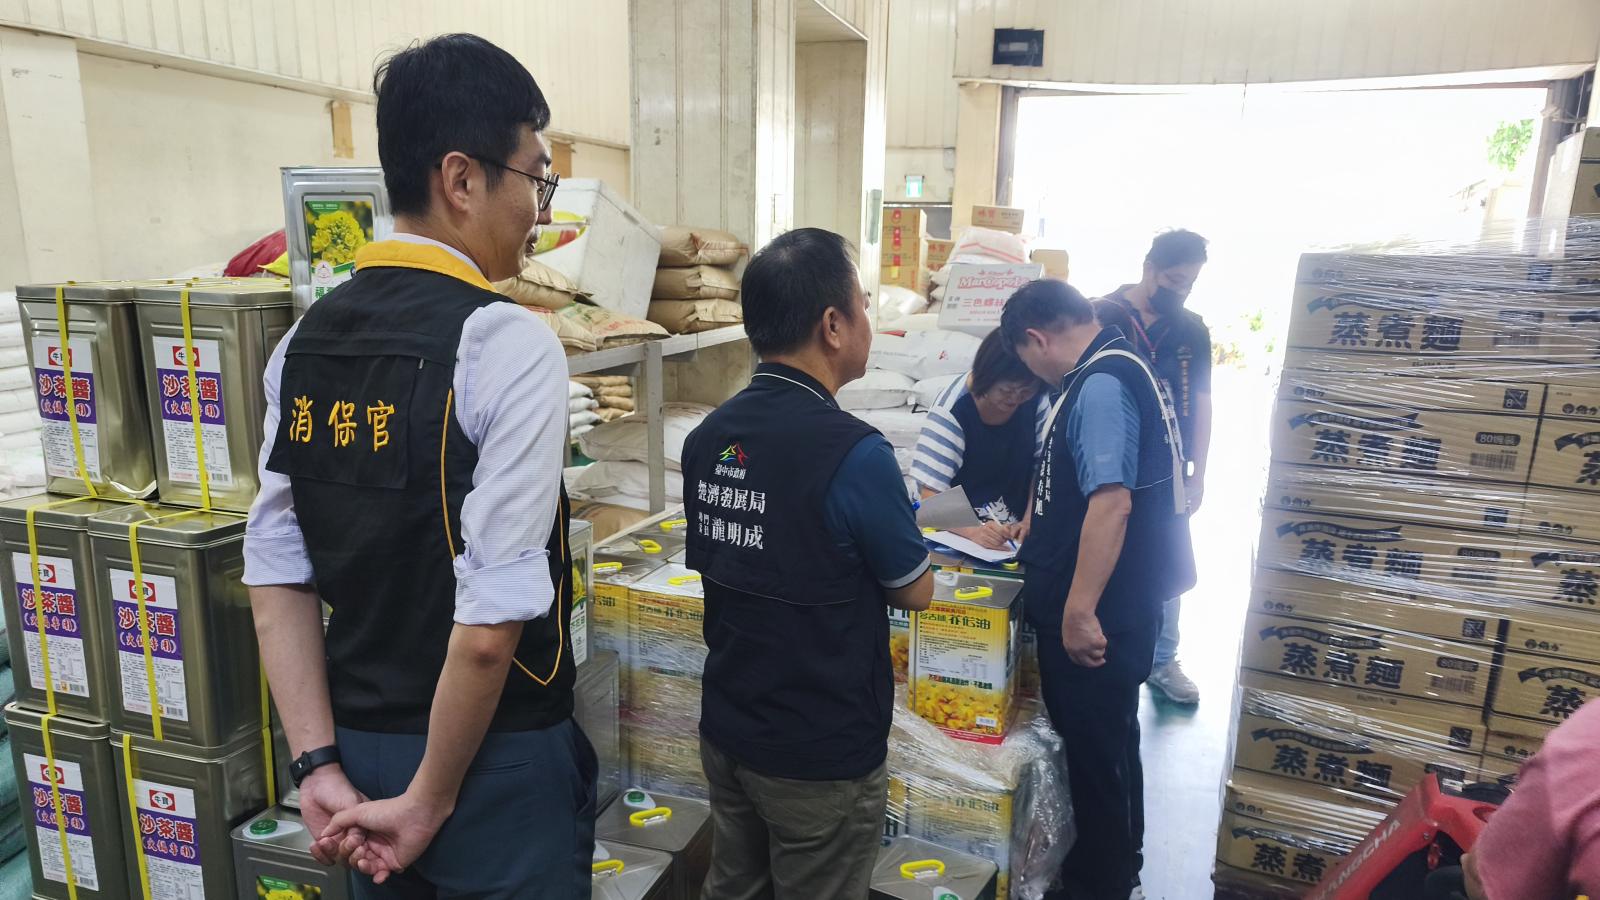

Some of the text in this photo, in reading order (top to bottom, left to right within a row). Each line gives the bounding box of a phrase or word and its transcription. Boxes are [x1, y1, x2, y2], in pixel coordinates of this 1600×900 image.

[290, 395, 395, 452] 消保官
[698, 480, 766, 514] 經濟發展局
[712, 516, 764, 550] 龍明成
[139, 813, 194, 844] 沙茶醬
[1251, 843, 1328, 882] 蒸煮
